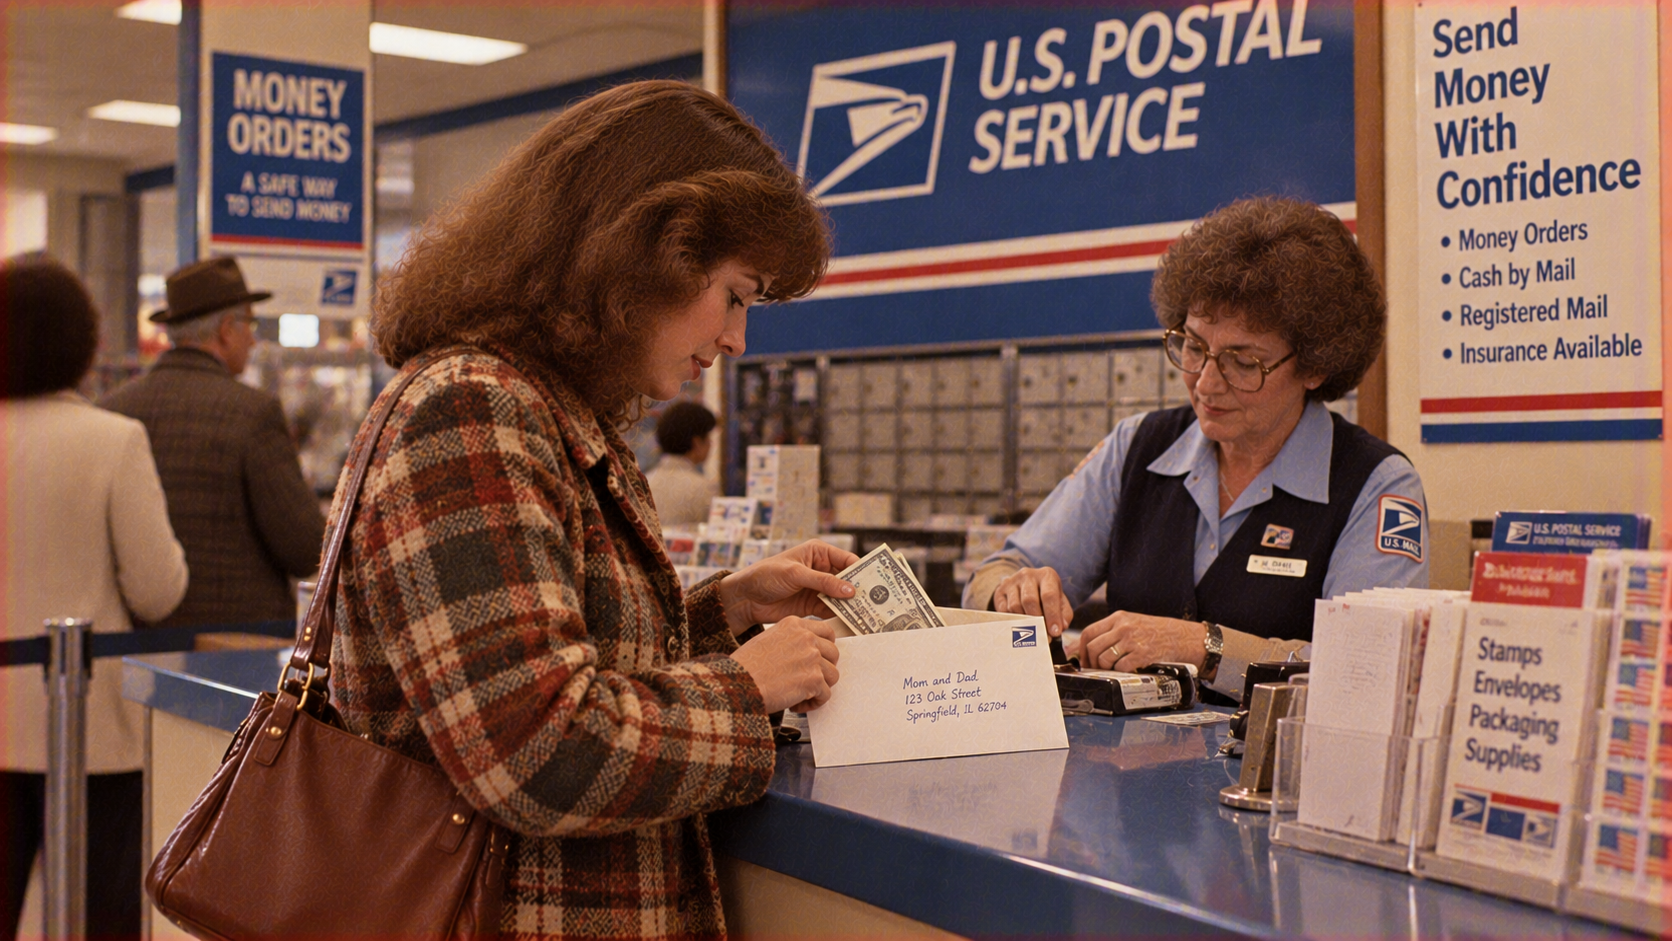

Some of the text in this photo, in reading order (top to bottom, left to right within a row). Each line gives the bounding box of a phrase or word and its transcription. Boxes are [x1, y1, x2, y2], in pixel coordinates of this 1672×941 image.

[979, 0, 1322, 100] U.S. POSTAL
[1433, 6, 1518, 58] Send
[233, 68, 347, 120] MONEY
[1435, 63, 1551, 109] Money
[227, 112, 351, 164] ORDERS
[968, 82, 1206, 174] SERVICE
[1434, 112, 1517, 159] With
[240, 171, 338, 199] A SAFE WAY
[1436, 158, 1641, 209] Confidence
[225, 193, 352, 224] TO SEND MONEY
[1459, 219, 1588, 253] Money Orders
[1459, 257, 1575, 290] Cash by Mail
[1460, 293, 1608, 331] Registered Mail
[1460, 332, 1643, 364] Insurance Available
[1477, 636, 1543, 670] Stamps
[903, 669, 979, 690] Mom and Dad
[905, 686, 982, 705] 123 Oak Street
[1473, 670, 1562, 706] Envelopes
[906, 701, 1007, 725] Springfield, IL 62704
[1468, 703, 1560, 745] Packaging
[1464, 737, 1542, 773] Supplies
